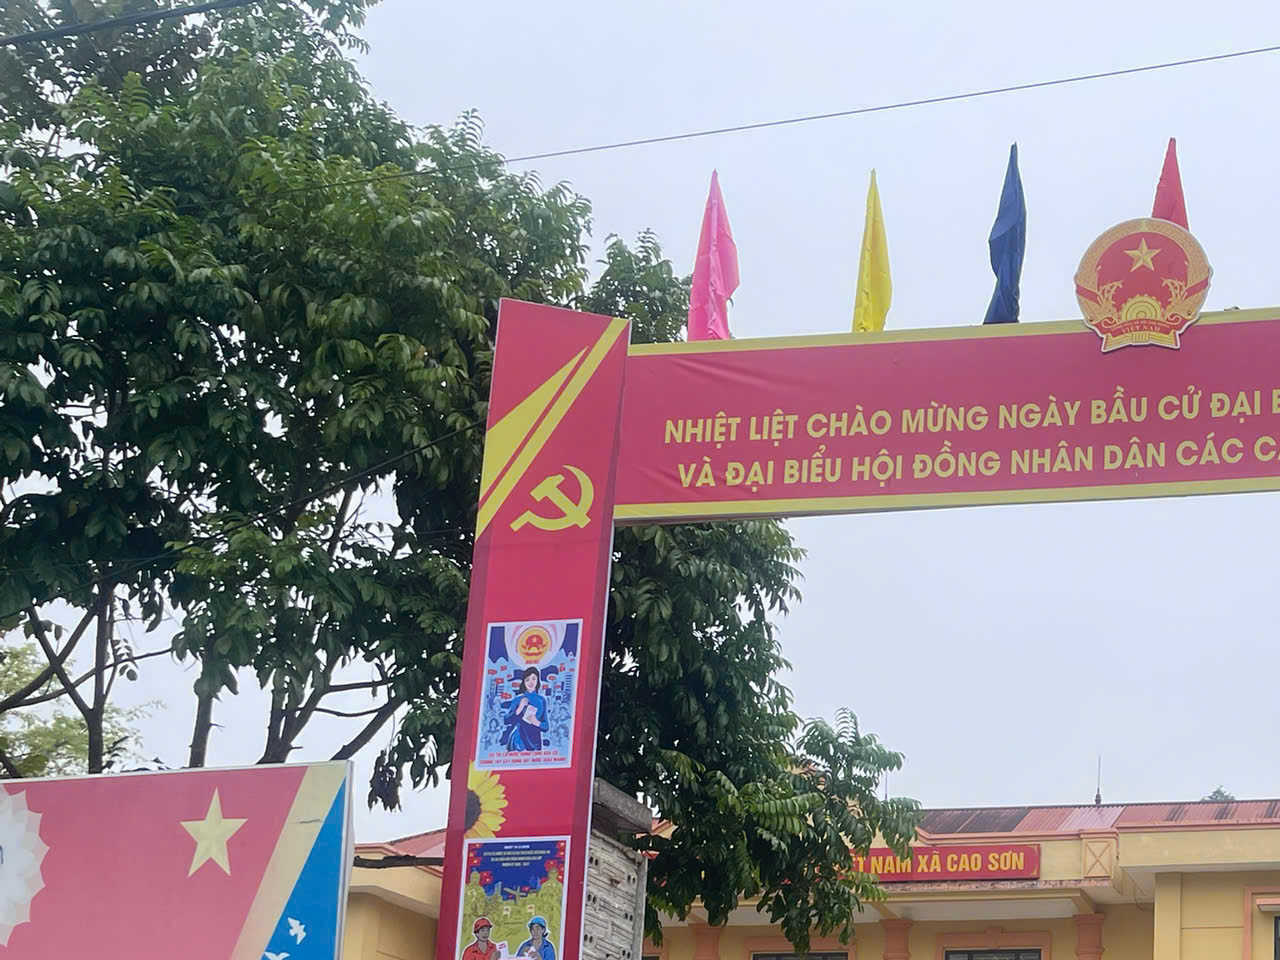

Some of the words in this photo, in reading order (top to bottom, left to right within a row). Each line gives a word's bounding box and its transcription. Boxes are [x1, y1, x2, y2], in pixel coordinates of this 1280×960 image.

[664, 411, 741, 449] NHIỆT
[750, 408, 799, 447] LIỆT
[806, 404, 892, 438] CHÀO
[901, 400, 989, 433] MỪNG
[998, 394, 1081, 429] NGÀY
[1090, 385, 1148, 424] BẦU
[1157, 385, 1202, 421] CỬ
[1209, 390, 1261, 424] ĐẠI
[678, 455, 716, 488] VÀ
[725, 460, 774, 493] ĐẠI
[783, 444, 842, 484] BIỂU
[851, 448, 903, 487] HỘI
[912, 439, 1001, 479] ĐỒNG
[1010, 440, 1094, 475] NHÂN
[1103, 436, 1166, 470] DÂN
[1175, 432, 1244, 466] CÁC
[870, 855, 912, 874] NAM
[917, 850, 942, 873] XÃ
[946, 852, 982, 872] CAO
[987, 850, 1025, 871] SƠN
